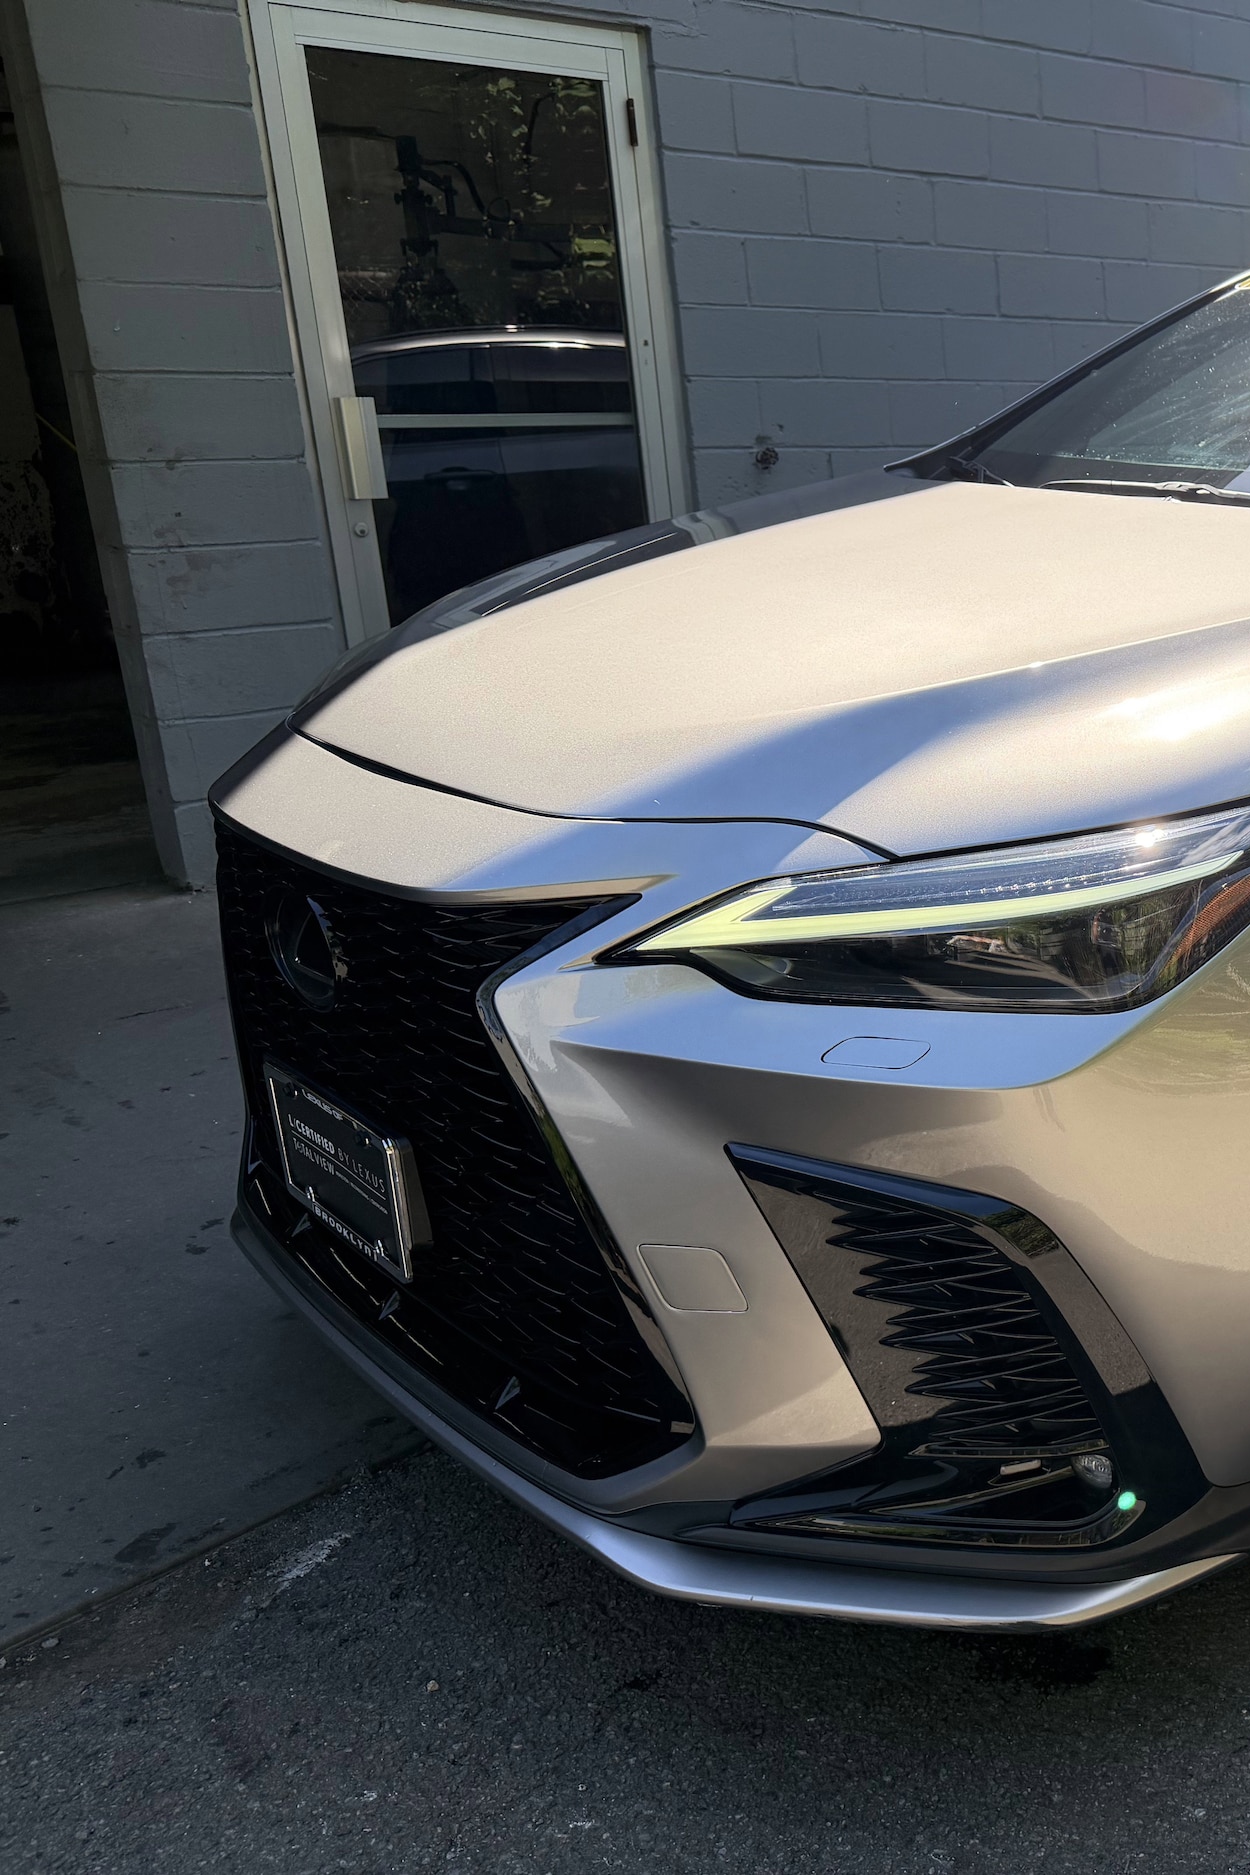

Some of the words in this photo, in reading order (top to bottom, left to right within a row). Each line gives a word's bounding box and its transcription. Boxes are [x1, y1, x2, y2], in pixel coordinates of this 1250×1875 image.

[301, 1088, 332, 1115] LEXUS
[337, 1147, 350, 1166] BY
[352, 1158, 385, 1193] LEXUS
[315, 1206, 372, 1257] BROOKLYN
